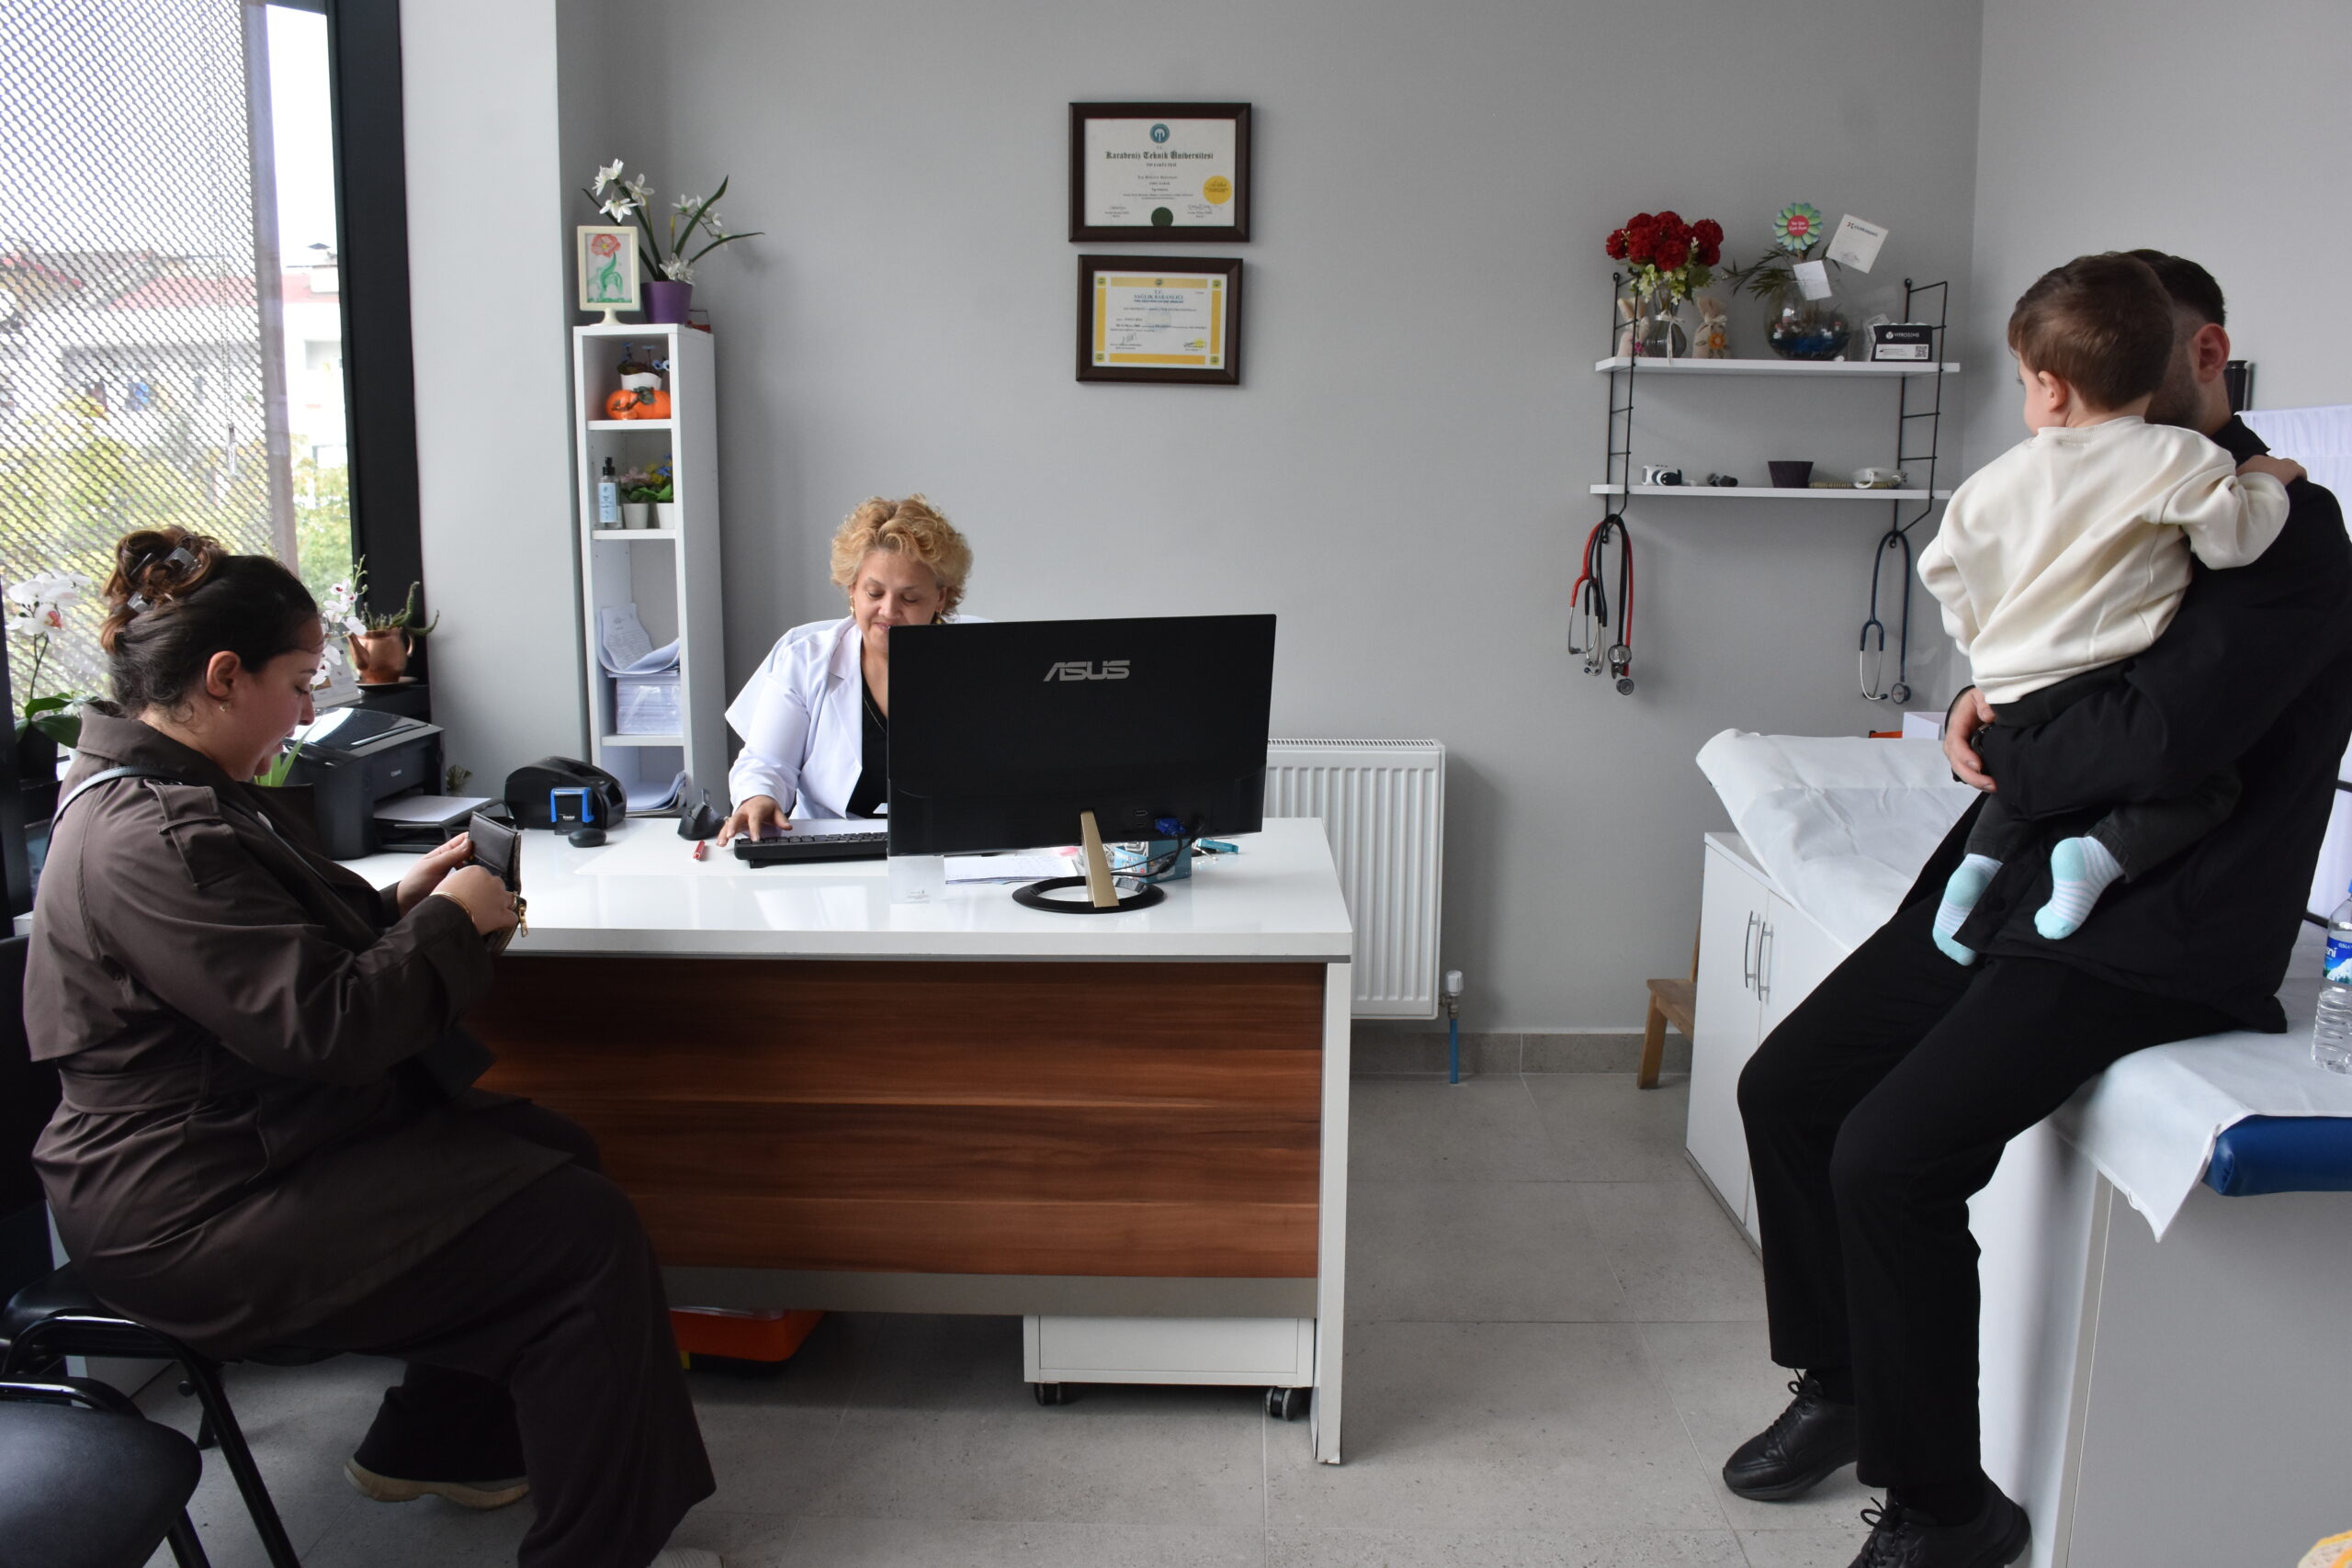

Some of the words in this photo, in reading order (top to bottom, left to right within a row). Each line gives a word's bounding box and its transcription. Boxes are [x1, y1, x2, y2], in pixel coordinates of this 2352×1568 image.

[1105, 151, 1141, 160] Karadeniz
[1143, 151, 1169, 160] Teknik
[1170, 150, 1214, 160] Üniversitesi
[1043, 660, 1131, 682] ASUS
